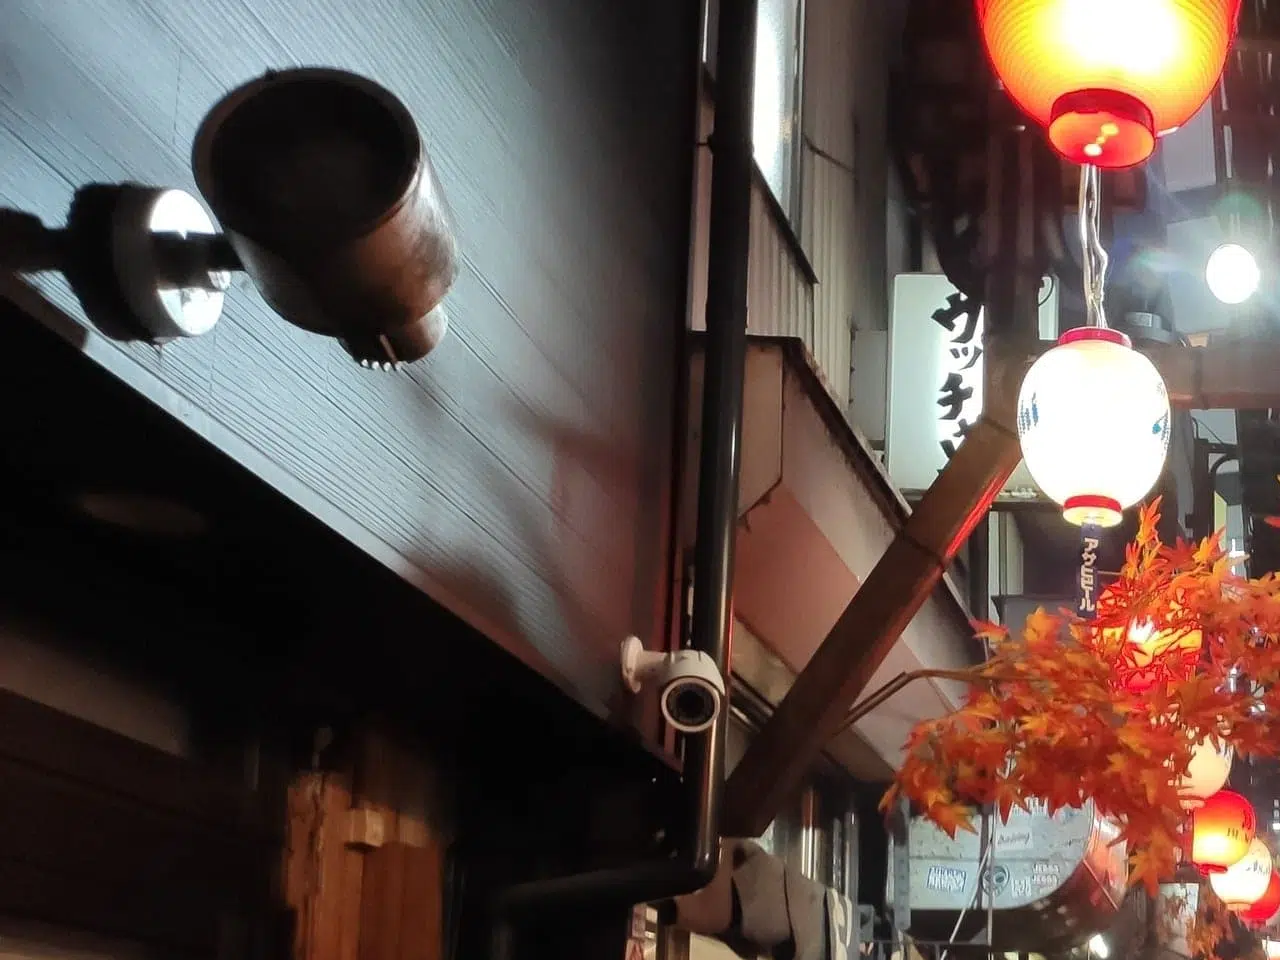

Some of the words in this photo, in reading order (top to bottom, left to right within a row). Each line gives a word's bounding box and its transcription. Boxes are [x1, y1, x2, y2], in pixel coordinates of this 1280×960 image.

[1079, 536, 1099, 613] アサヒビール
